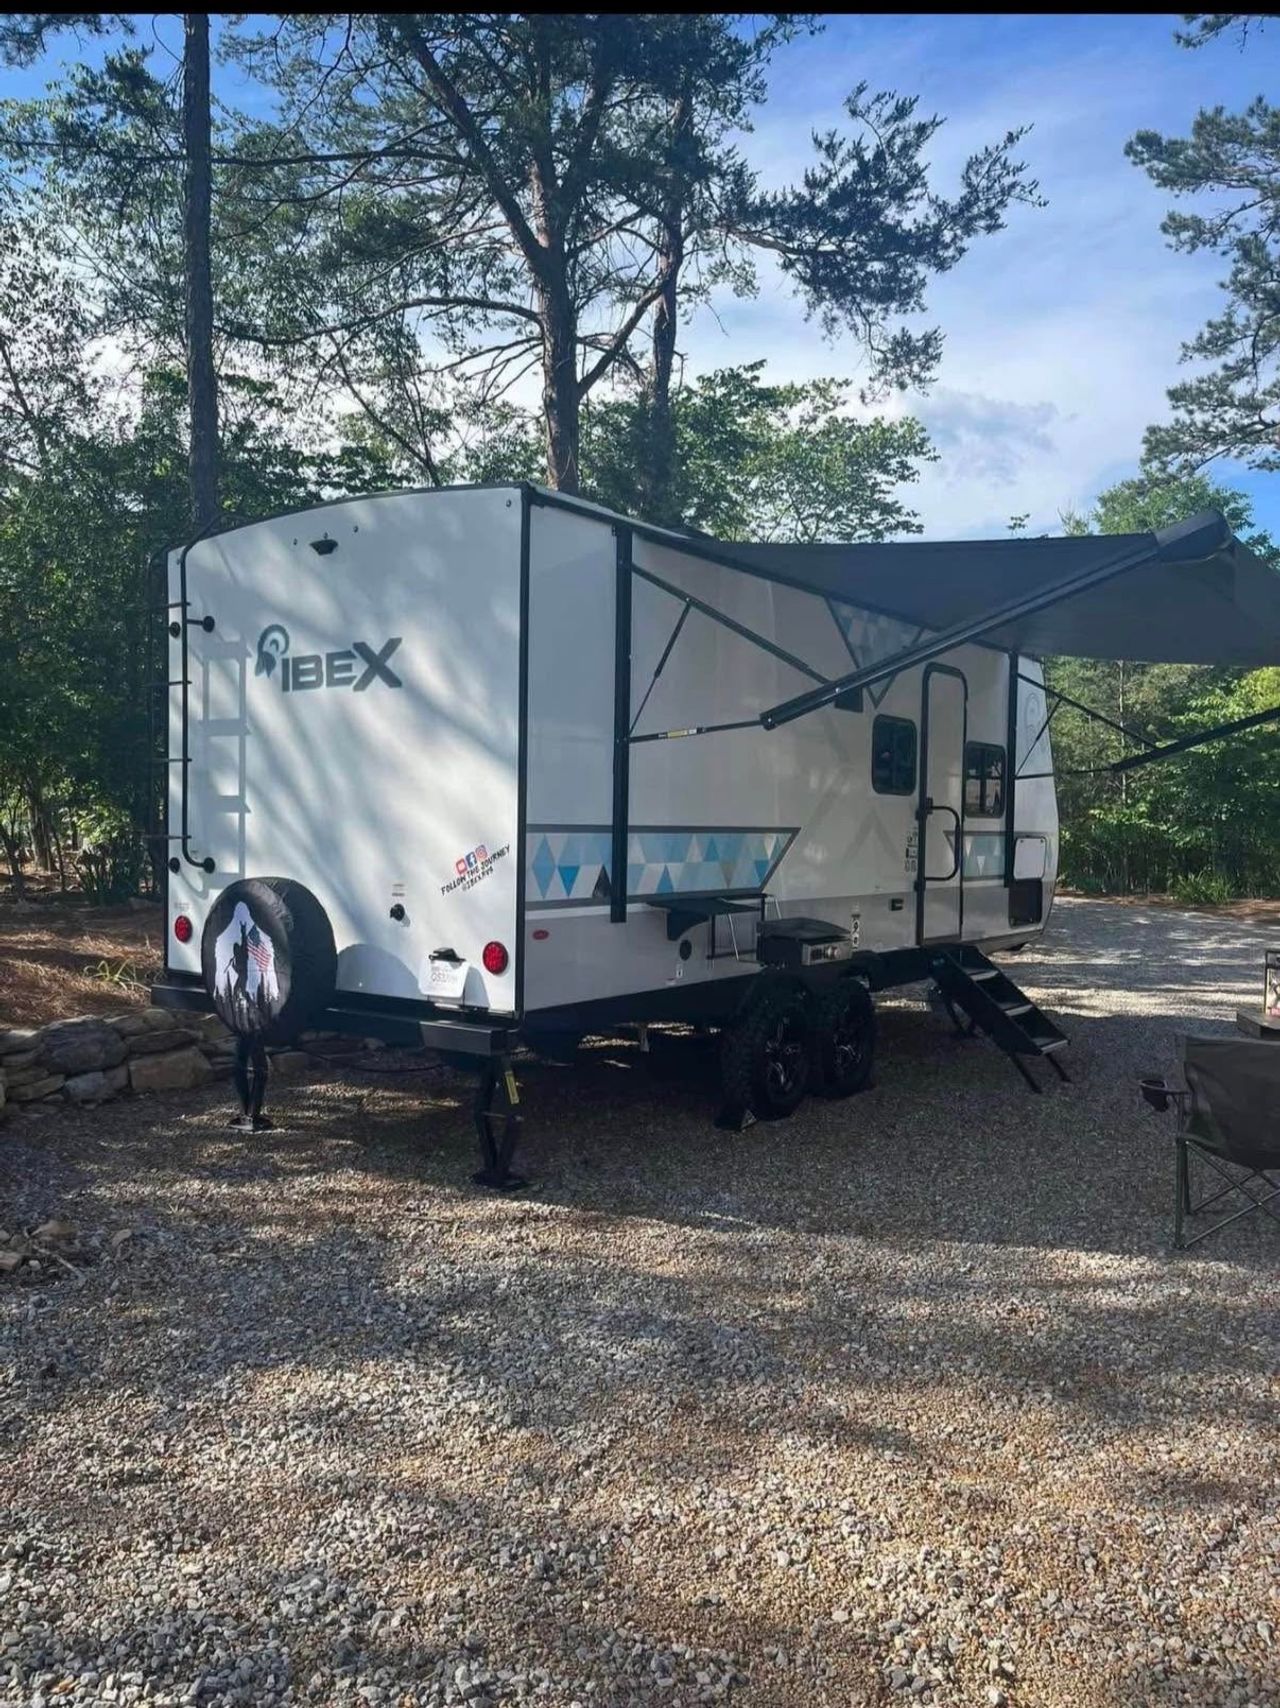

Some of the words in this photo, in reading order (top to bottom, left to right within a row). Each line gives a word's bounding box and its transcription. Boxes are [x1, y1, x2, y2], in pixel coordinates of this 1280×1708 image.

[282, 637, 402, 692] IBEX
[441, 875, 466, 896] FOLLOW
[467, 866, 480, 878] THE
[481, 845, 509, 870] JOURNEY
